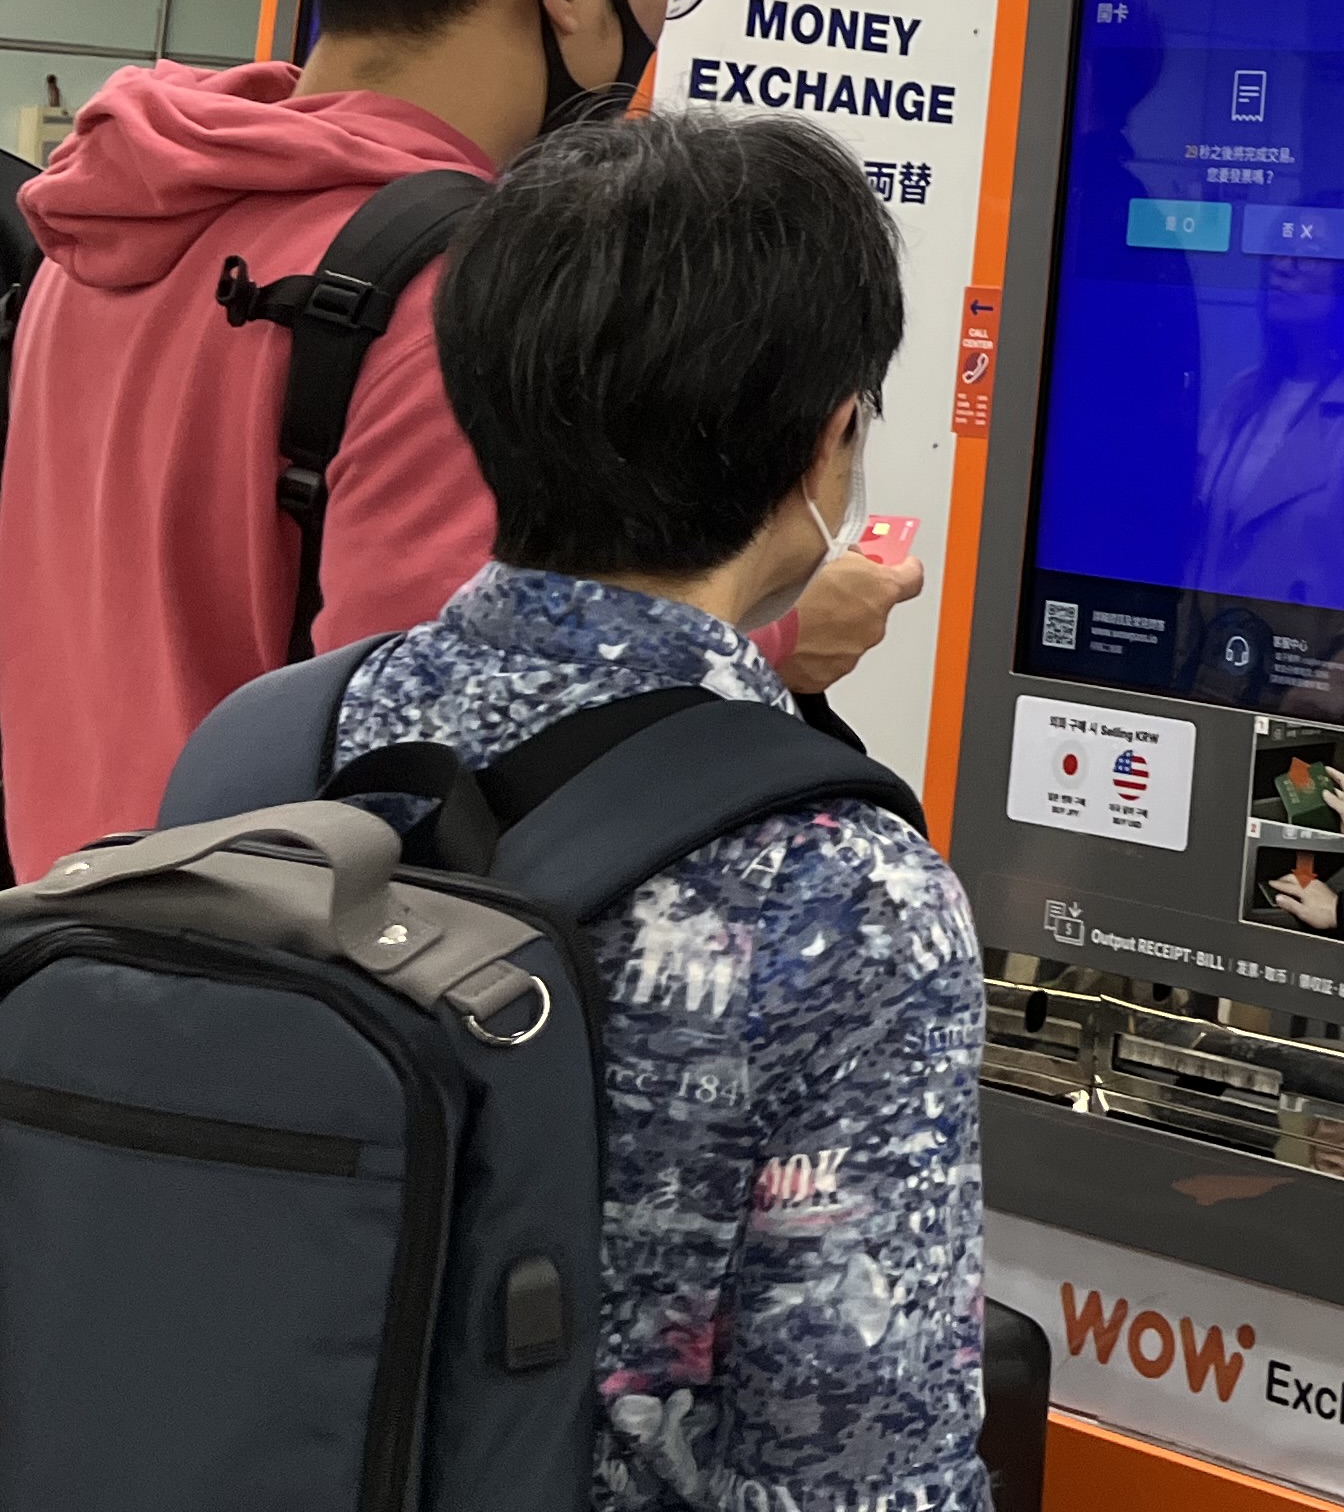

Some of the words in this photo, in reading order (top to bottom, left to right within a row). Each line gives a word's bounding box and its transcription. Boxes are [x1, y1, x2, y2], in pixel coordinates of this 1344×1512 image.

[688, 58, 956, 124] EXCHANGE
[864, 160, 932, 205] 両替
[1091, 929, 1136, 951] Output
